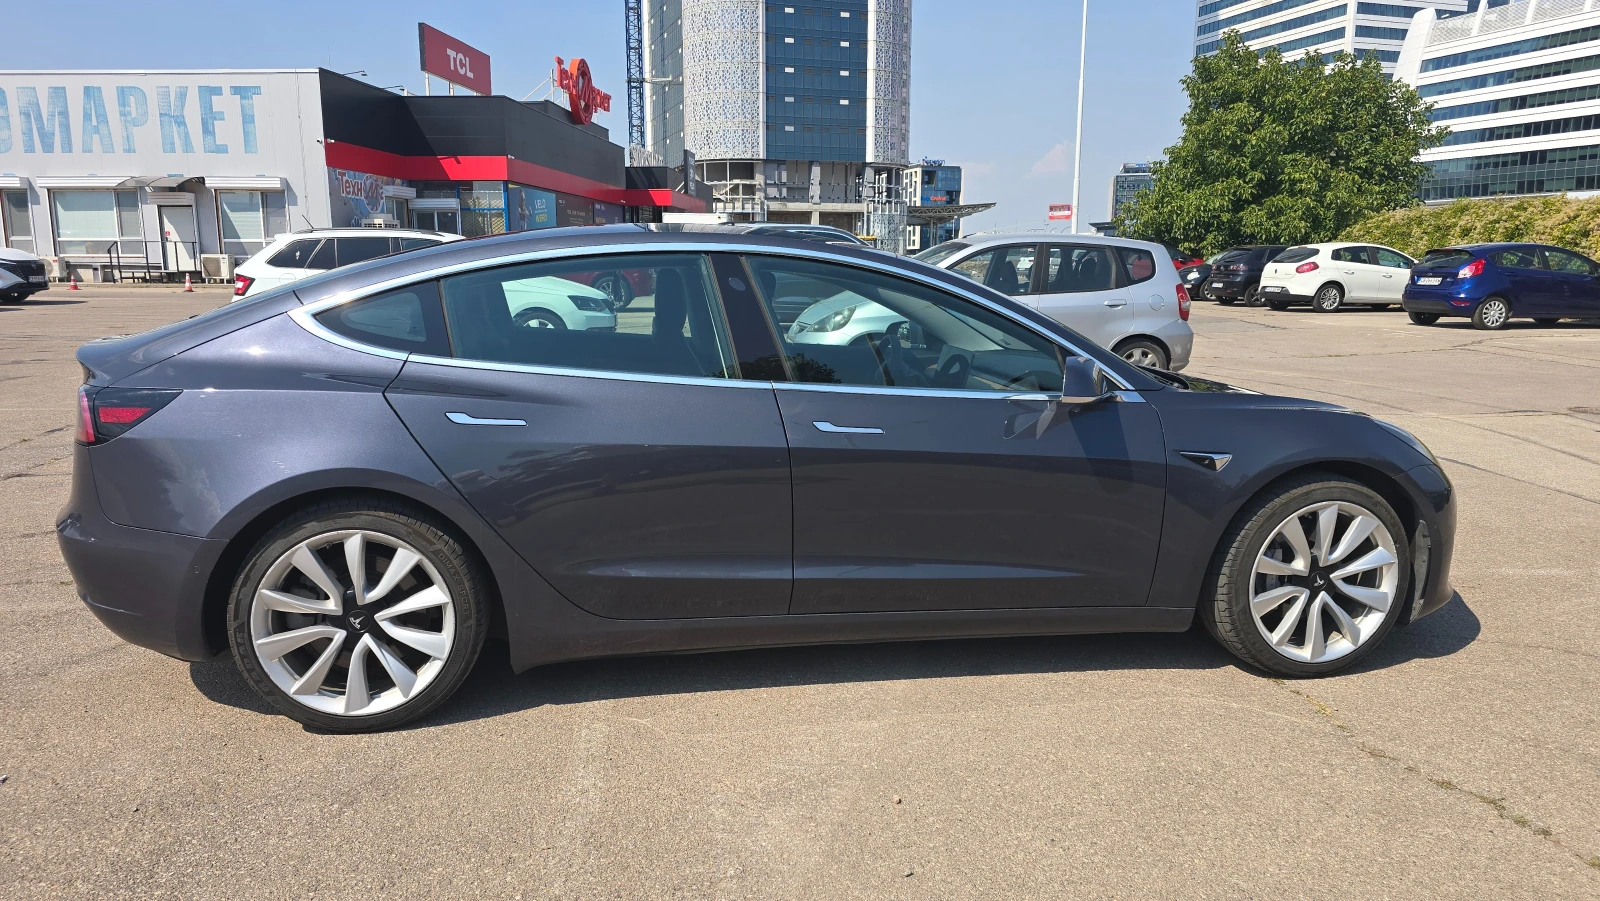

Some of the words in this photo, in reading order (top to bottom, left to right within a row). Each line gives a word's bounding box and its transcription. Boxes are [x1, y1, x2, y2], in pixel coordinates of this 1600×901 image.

[446, 48, 474, 79] TCL
[437, 552, 460, 582] DIMAX
[457, 584, 470, 617] SPORT
